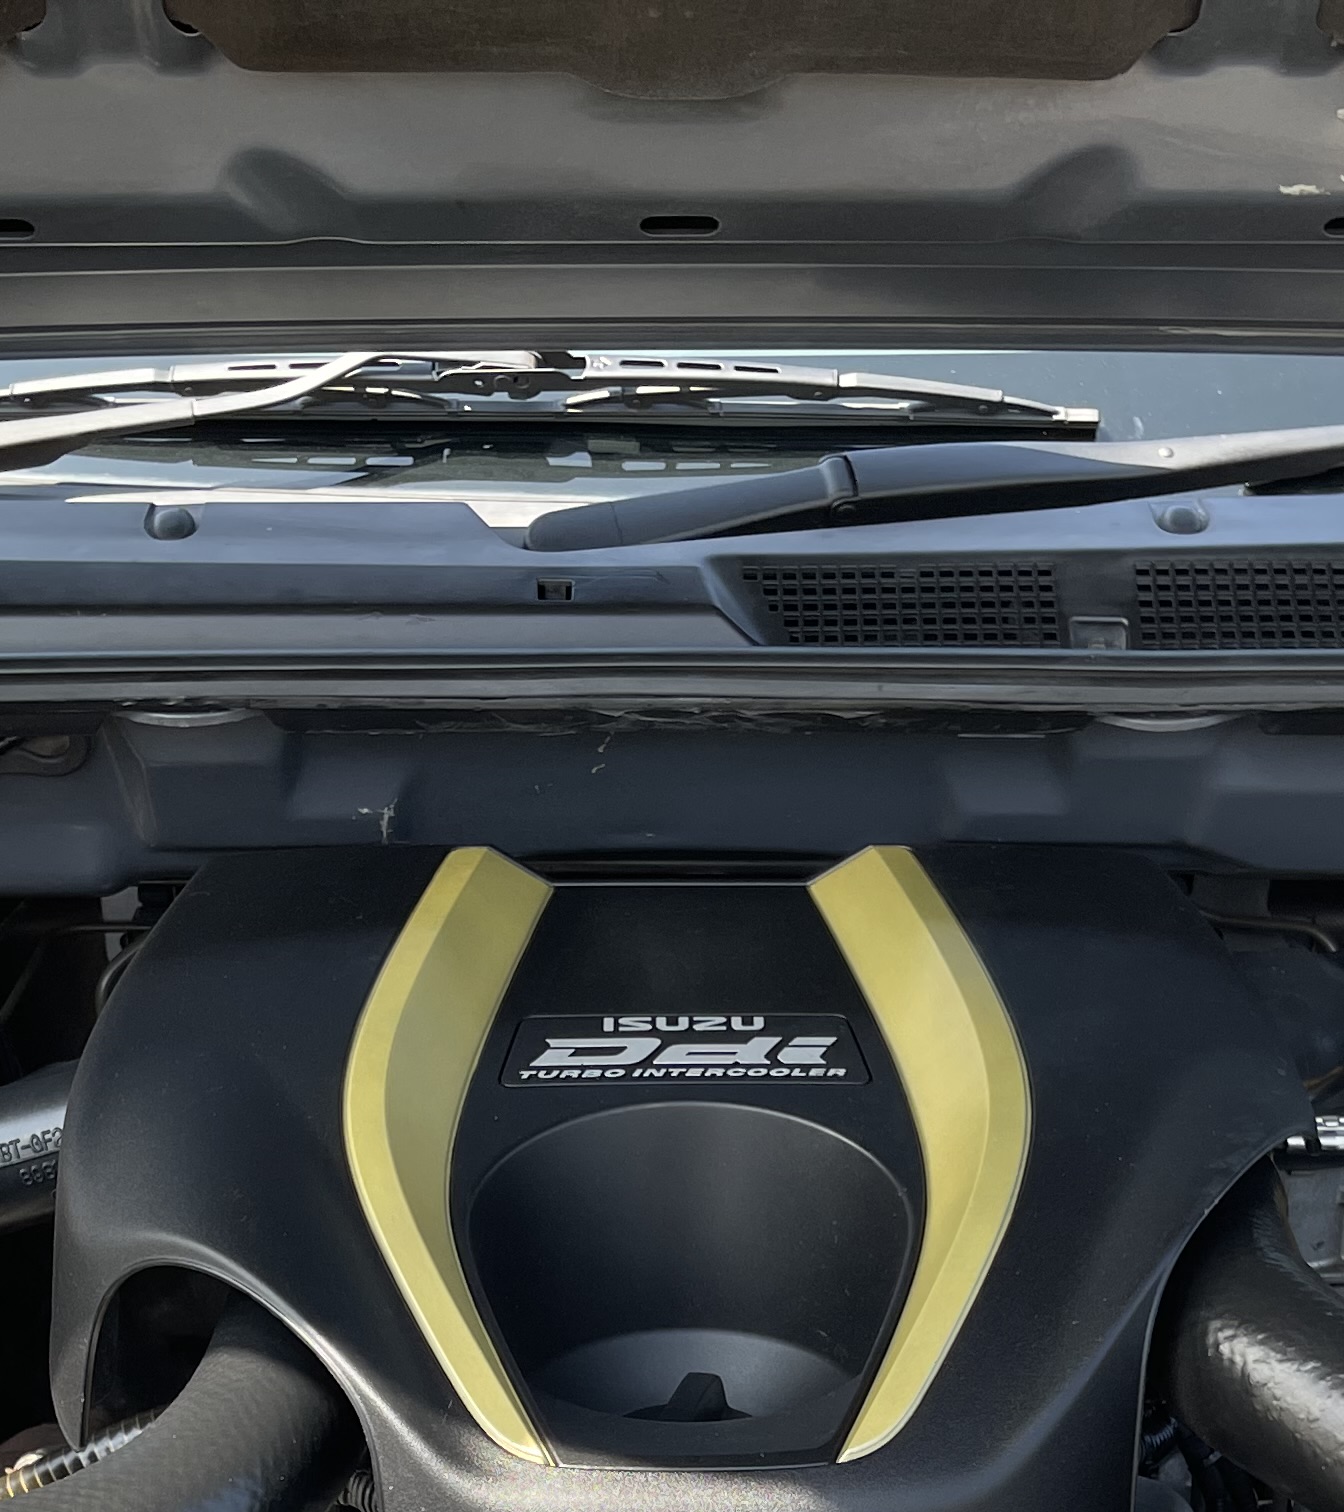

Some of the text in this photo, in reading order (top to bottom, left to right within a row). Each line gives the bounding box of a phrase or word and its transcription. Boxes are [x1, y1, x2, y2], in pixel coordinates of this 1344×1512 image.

[603, 1016, 765, 1032] ISUZU
[519, 1067, 847, 1080] TURBO INTERCOOLER
